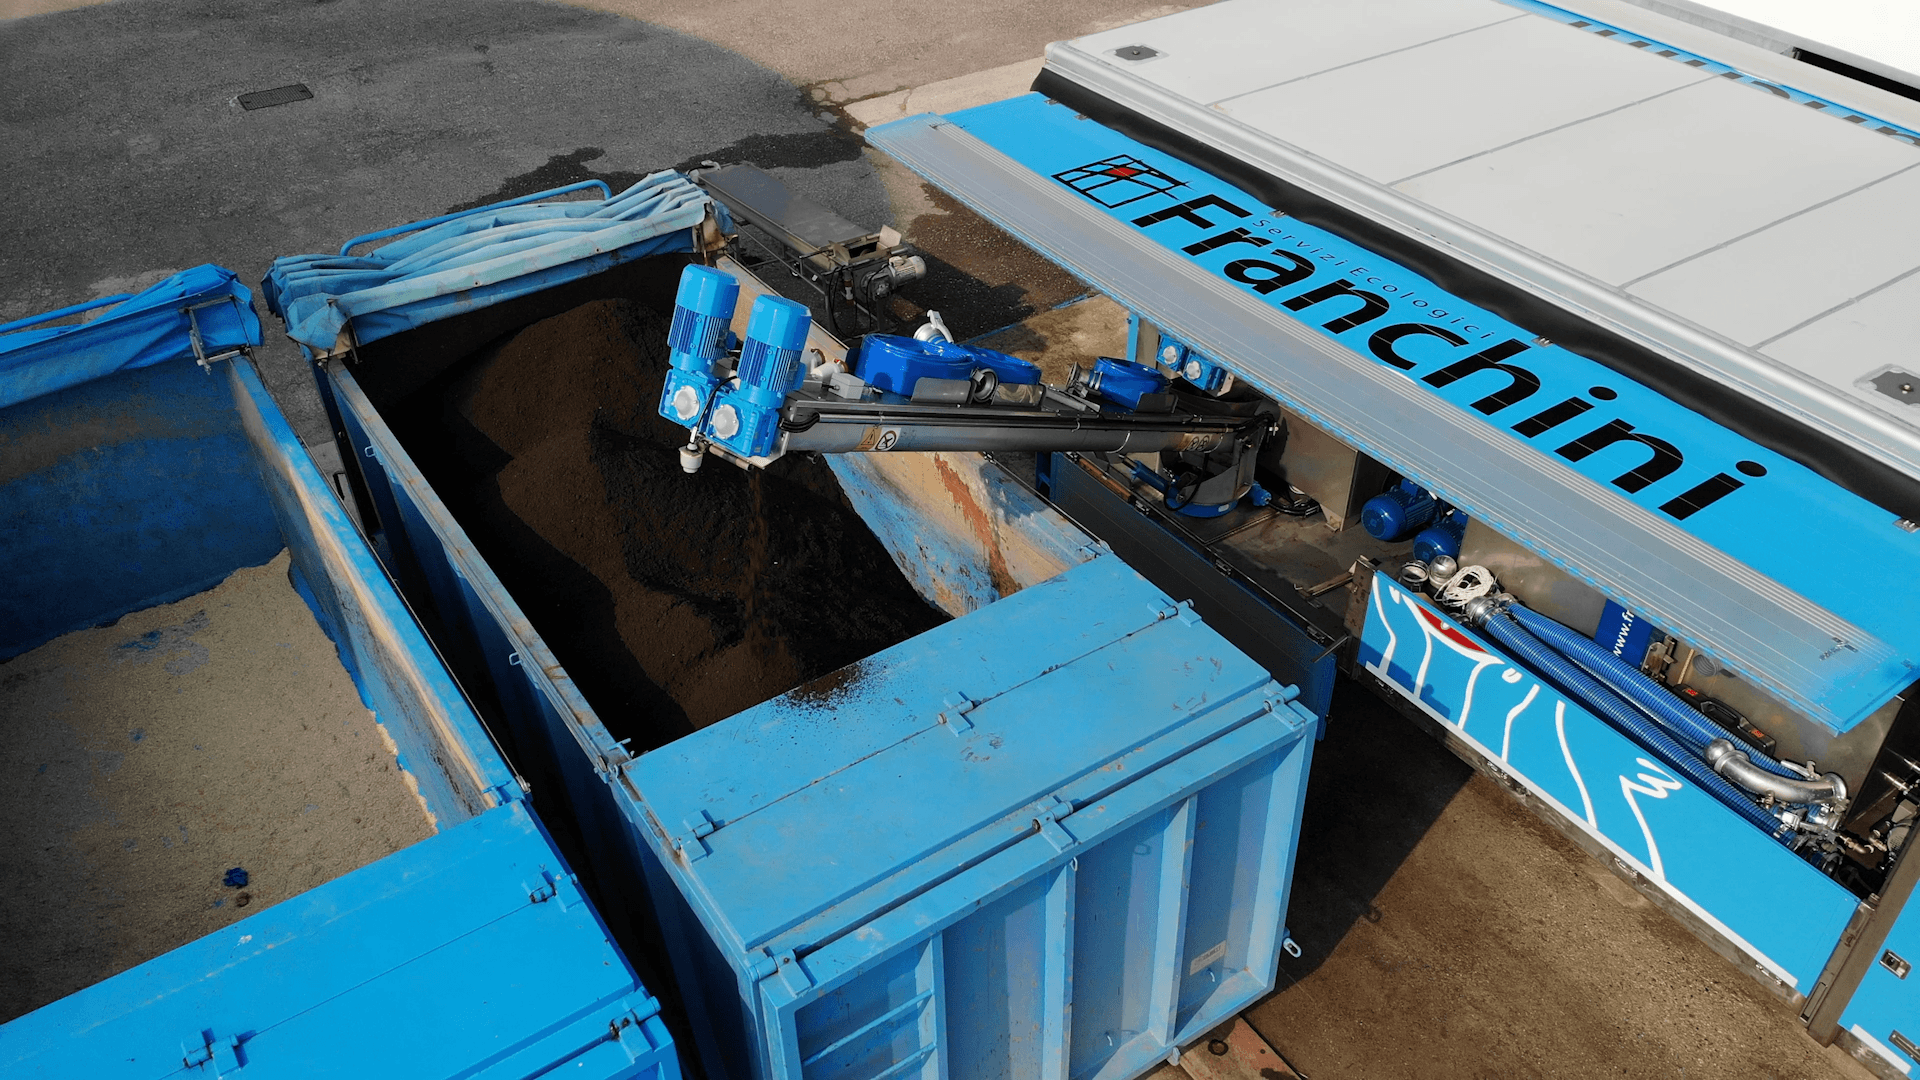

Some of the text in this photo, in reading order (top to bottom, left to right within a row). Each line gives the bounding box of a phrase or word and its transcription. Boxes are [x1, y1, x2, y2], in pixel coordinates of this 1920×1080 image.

[1130, 194, 1767, 521] Franchini
[1253, 218, 1495, 340] Servizi Ecologici
